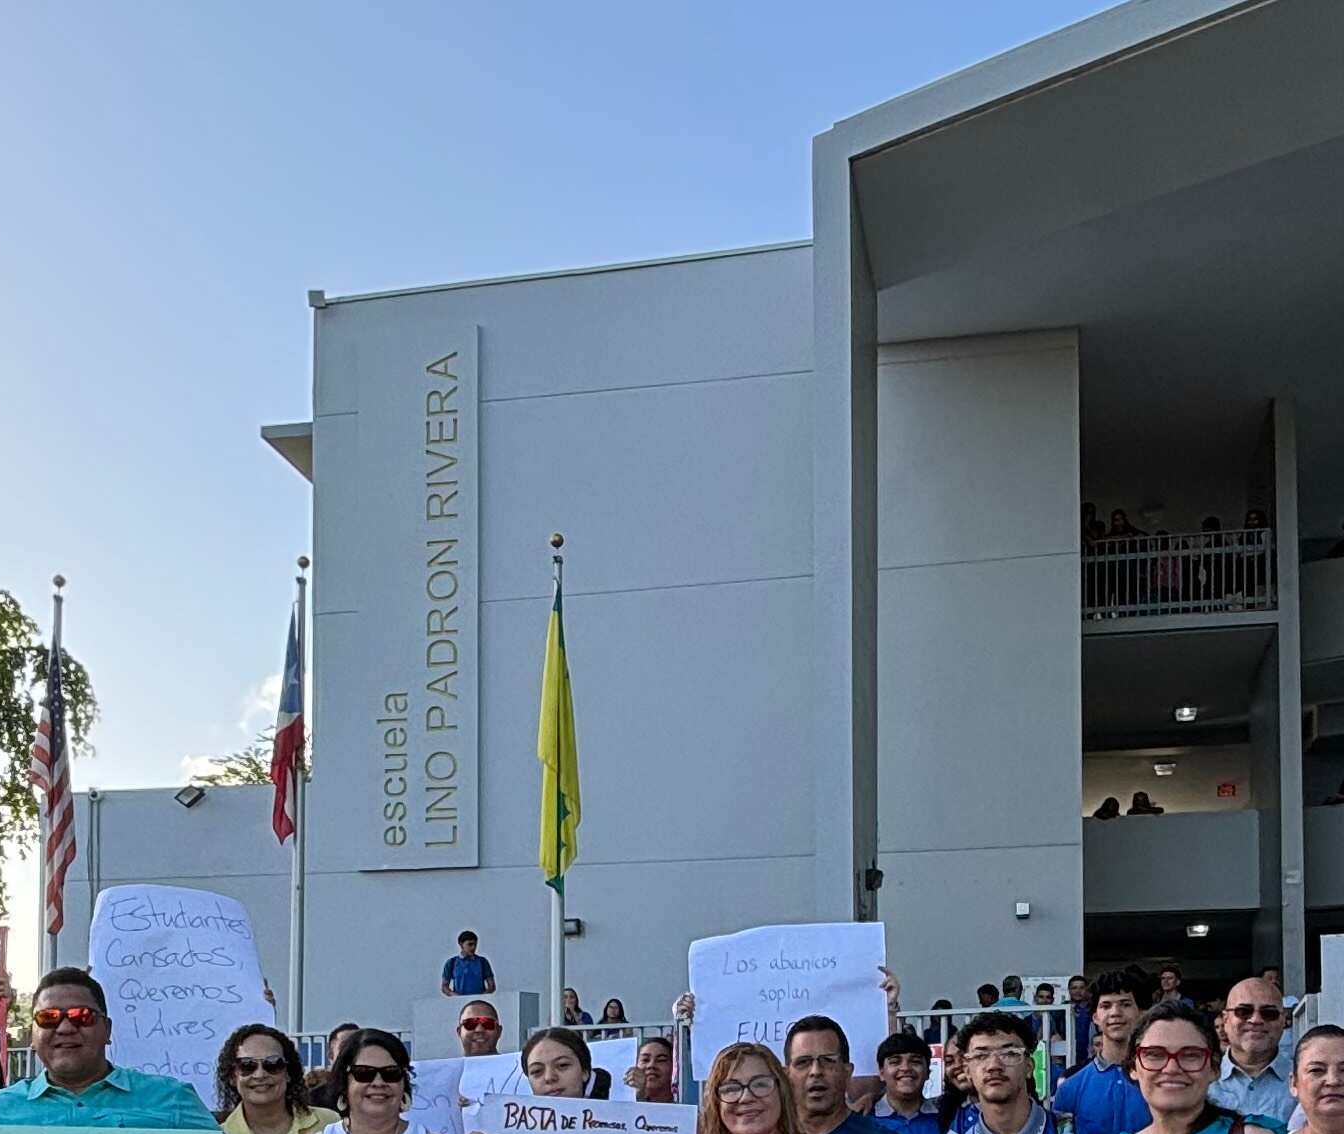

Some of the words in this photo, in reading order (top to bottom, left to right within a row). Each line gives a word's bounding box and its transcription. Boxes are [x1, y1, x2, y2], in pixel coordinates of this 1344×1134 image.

[425, 351, 459, 521] RIVERA
[425, 538, 459, 732] PADRON
[375, 691, 408, 848] escuela
[424, 751, 458, 849] LINO
[110, 896, 252, 940] Estudiantes
[106, 938, 244, 970] Cansados,
[723, 952, 758, 976] Los
[769, 949, 837, 972] abanicos
[119, 978, 244, 1004] Queremos
[759, 982, 810, 1012] soplan
[503, 1103, 558, 1132] BASTA
[560, 1115, 578, 1131] DE
